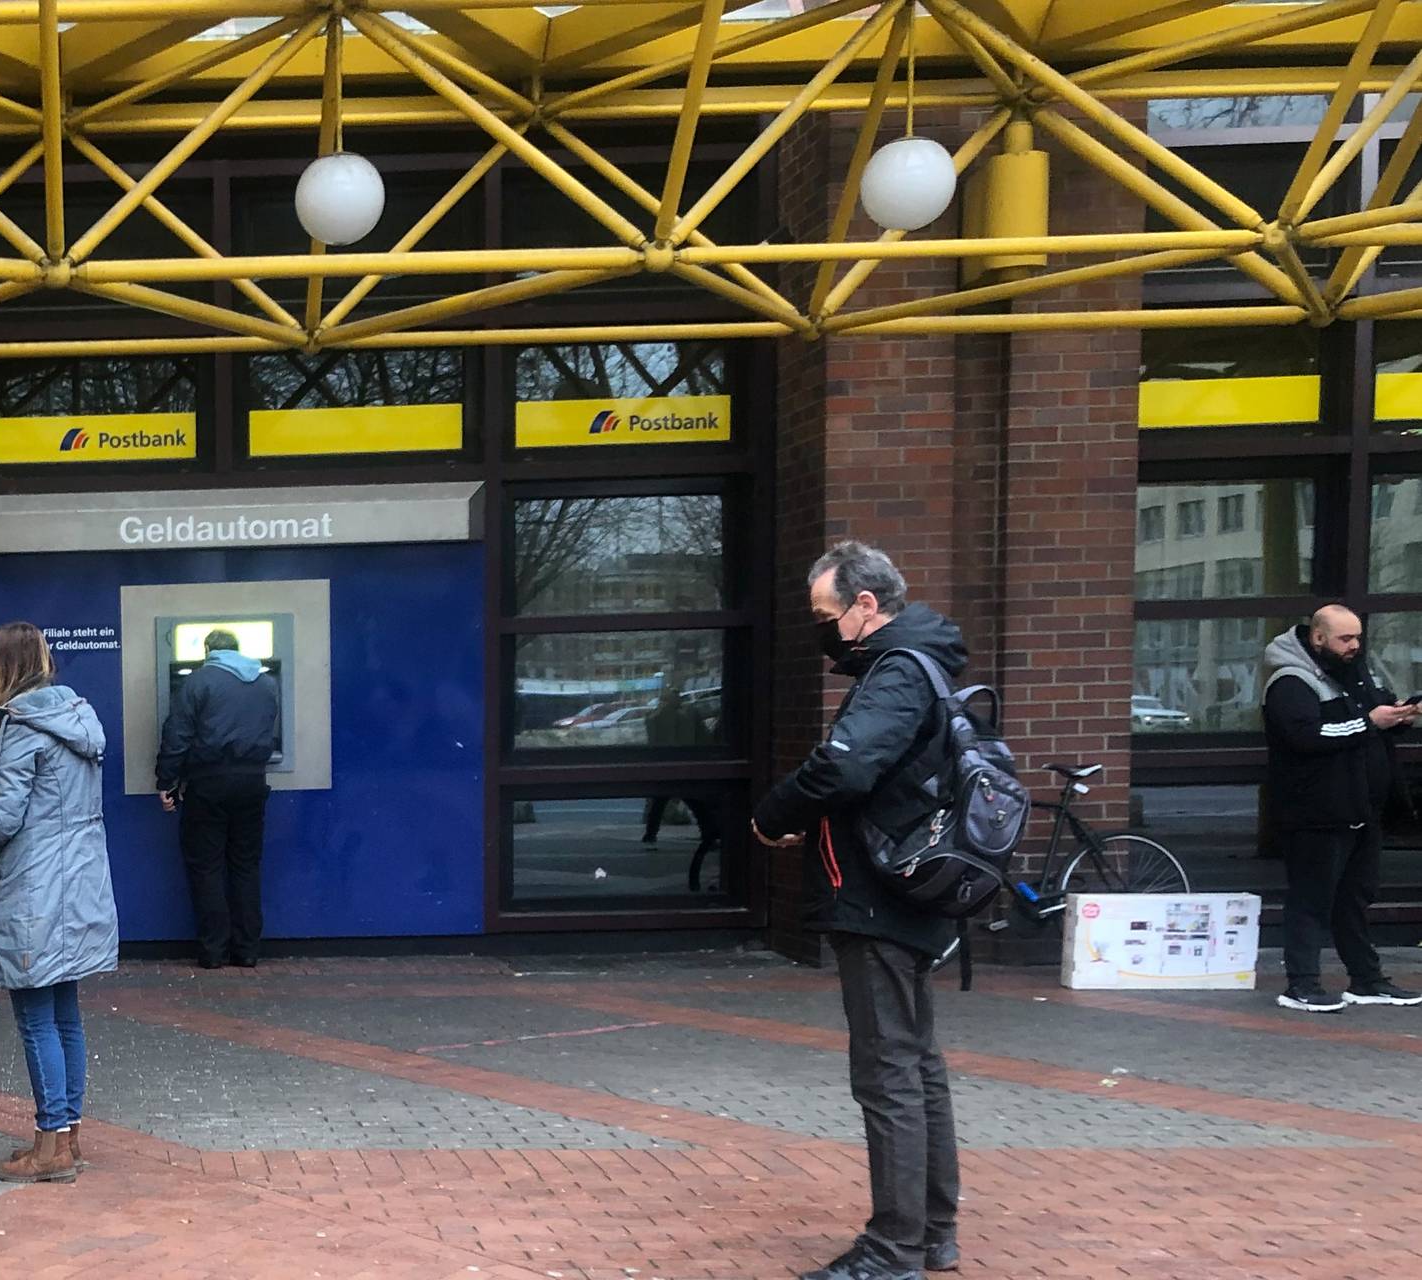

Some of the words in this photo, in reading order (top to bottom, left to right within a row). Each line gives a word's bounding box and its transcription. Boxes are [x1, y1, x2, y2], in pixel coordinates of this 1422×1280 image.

[629, 411, 719, 432] Postbank
[98, 428, 187, 449] Postbank
[119, 512, 334, 544] Geldautomat
[43, 628, 71, 637] Filiale
[73, 628, 97, 637] steht
[99, 627, 115, 636] ein
[56, 640, 121, 650] Geldautomat.
